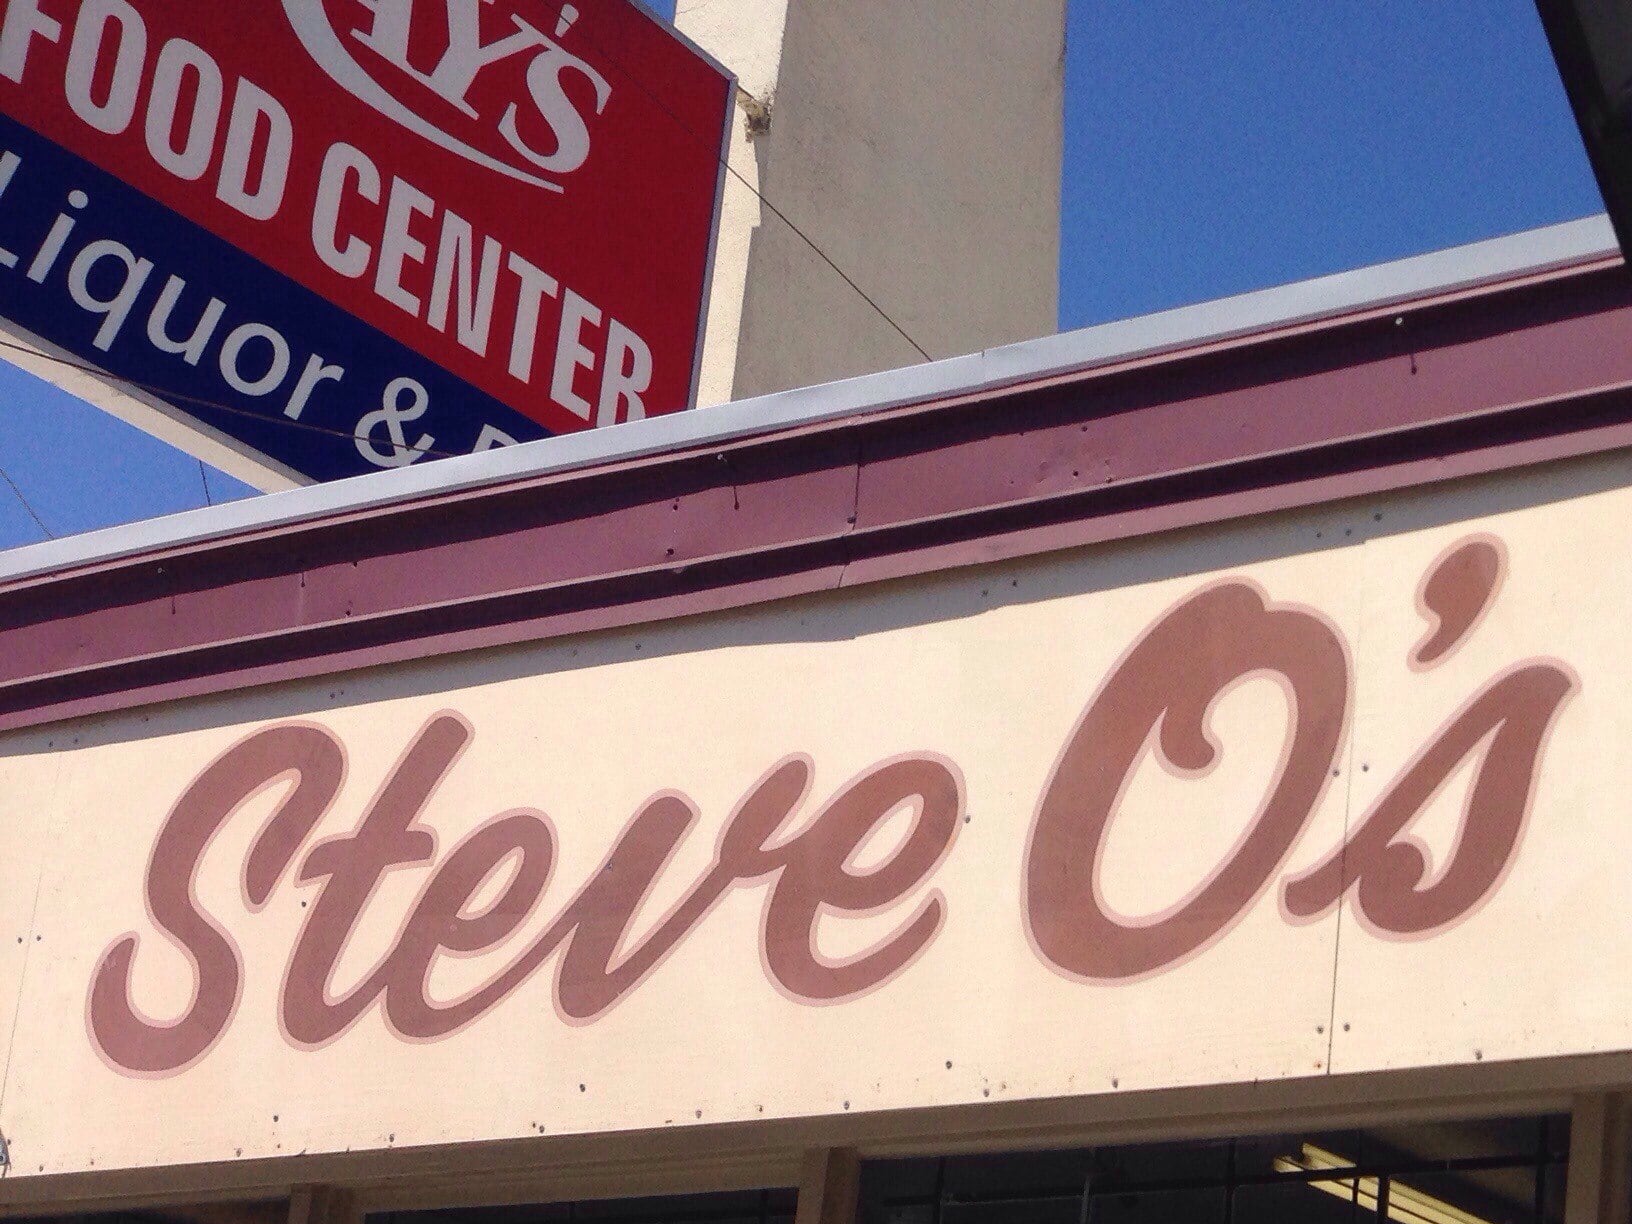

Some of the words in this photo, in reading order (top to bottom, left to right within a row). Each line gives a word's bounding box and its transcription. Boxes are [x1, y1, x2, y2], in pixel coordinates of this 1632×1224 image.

[311, 141, 653, 431] CENTER
[354, 377, 435, 468] &
[86, 708, 967, 1081] Steve
[1020, 531, 1582, 987] O's
